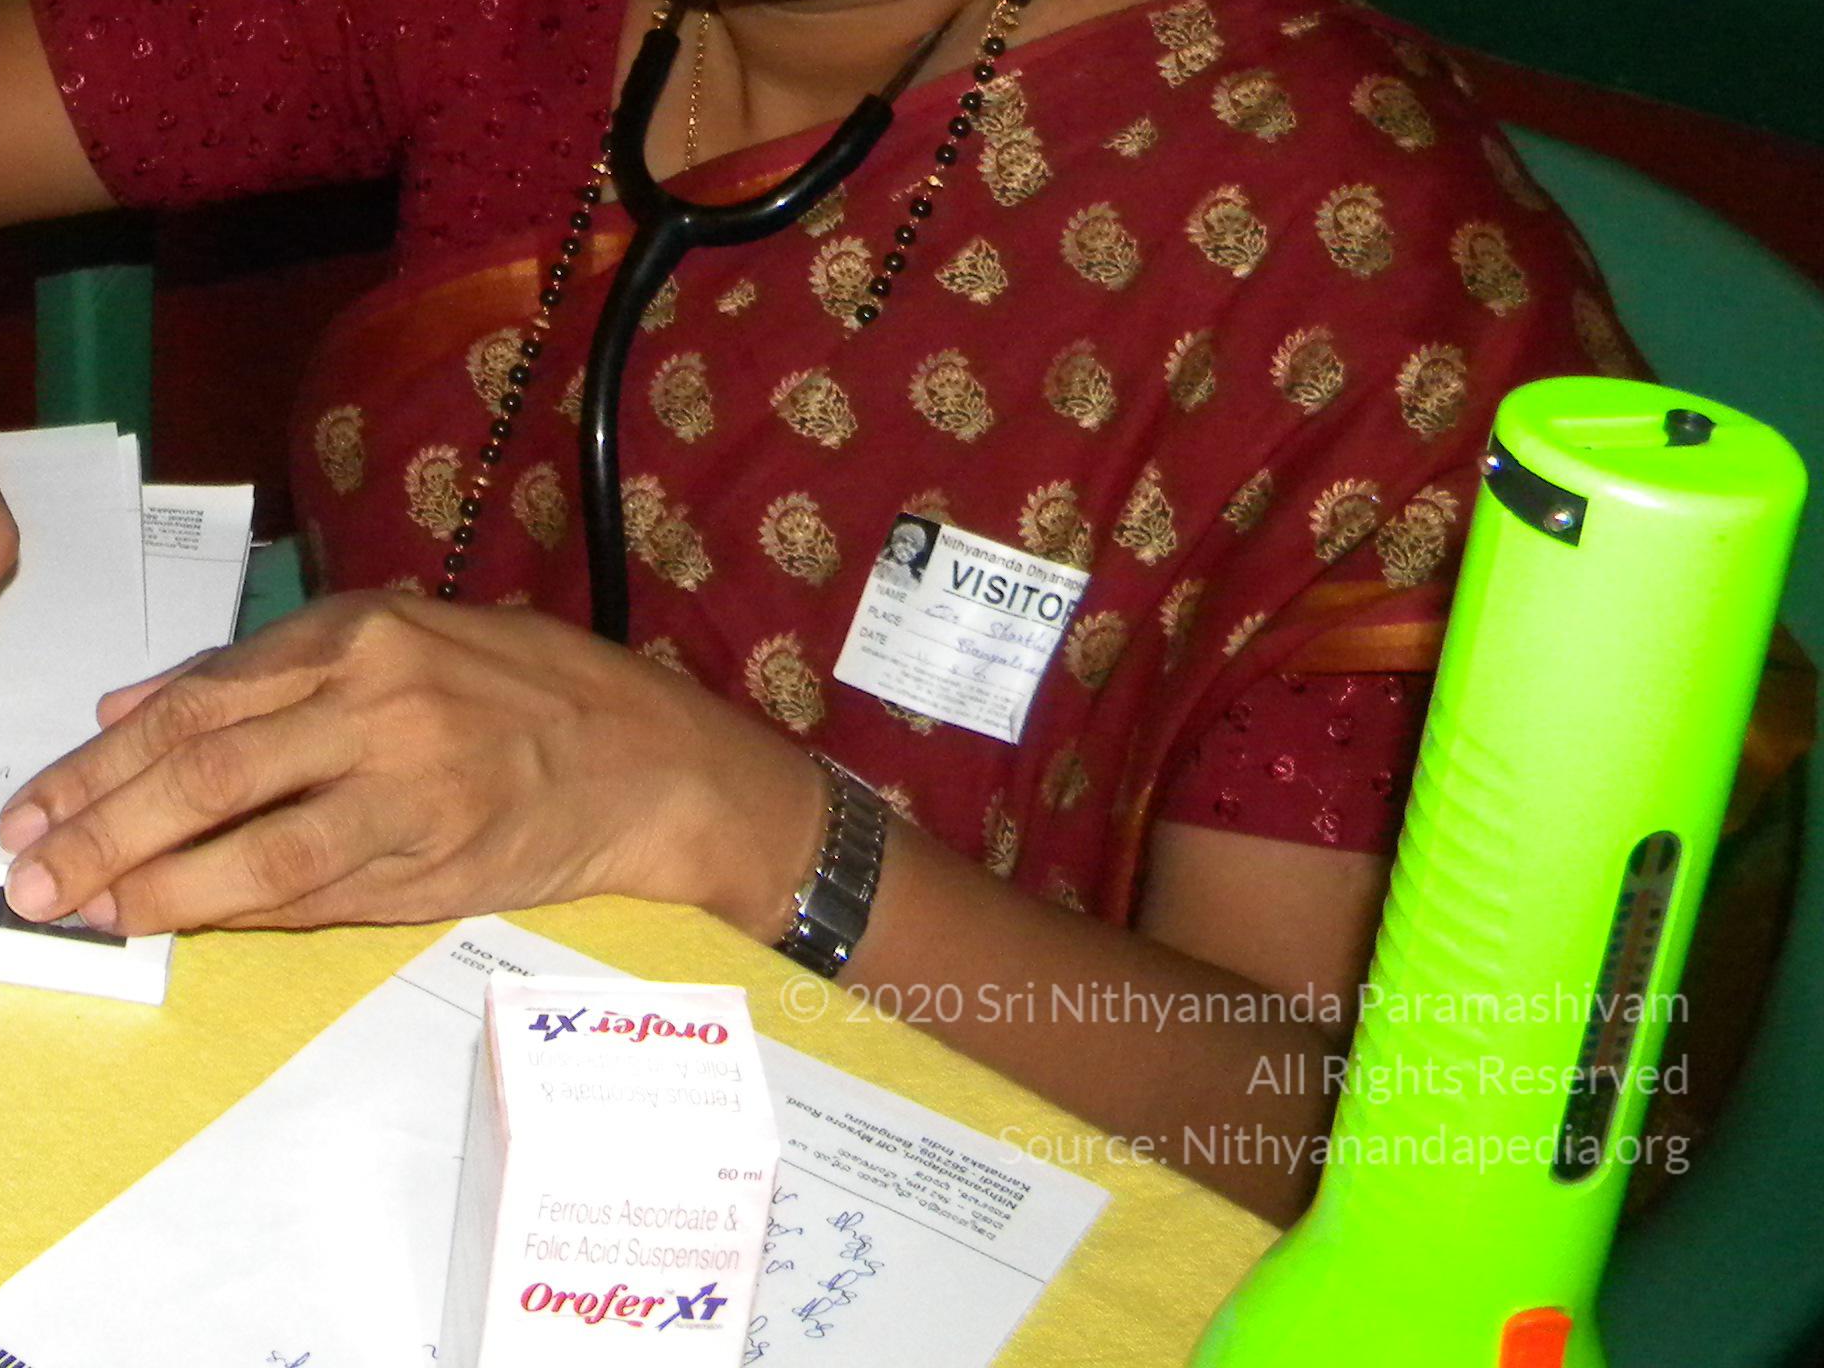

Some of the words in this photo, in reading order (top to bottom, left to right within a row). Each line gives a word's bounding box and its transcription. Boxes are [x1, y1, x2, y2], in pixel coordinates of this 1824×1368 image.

[939, 534, 1024, 574] Nithyananda
[876, 584, 908, 604] NAME
[867, 605, 904, 627] PLACE
[859, 626, 887, 646] DATE
[529, 1007, 589, 1042] XT
[590, 1012, 728, 1045] Orofer
[824, 1114, 875, 1145] Mysore
[843, 1112, 914, 1151] Bengaluru
[874, 1139, 898, 1154] Off
[920, 1136, 955, 1157] India
[718, 1168, 738, 1181] 60
[743, 1169, 762, 1181] ml
[902, 1147, 1019, 1211] Nithyanandapuri,
[959, 1152, 1032, 1194] Karnataka,
[978, 1175, 1025, 1202] Bidadi
[538, 1194, 611, 1225] Ferrous
[619, 1199, 718, 1231] Ascorbate
[725, 1205, 738, 1231] &
[525, 1232, 569, 1262] Folic
[577, 1236, 619, 1265] Acid
[626, 1238, 740, 1273] Suspension
[520, 1282, 665, 1324] Orofer
[656, 1282, 728, 1331] XT
